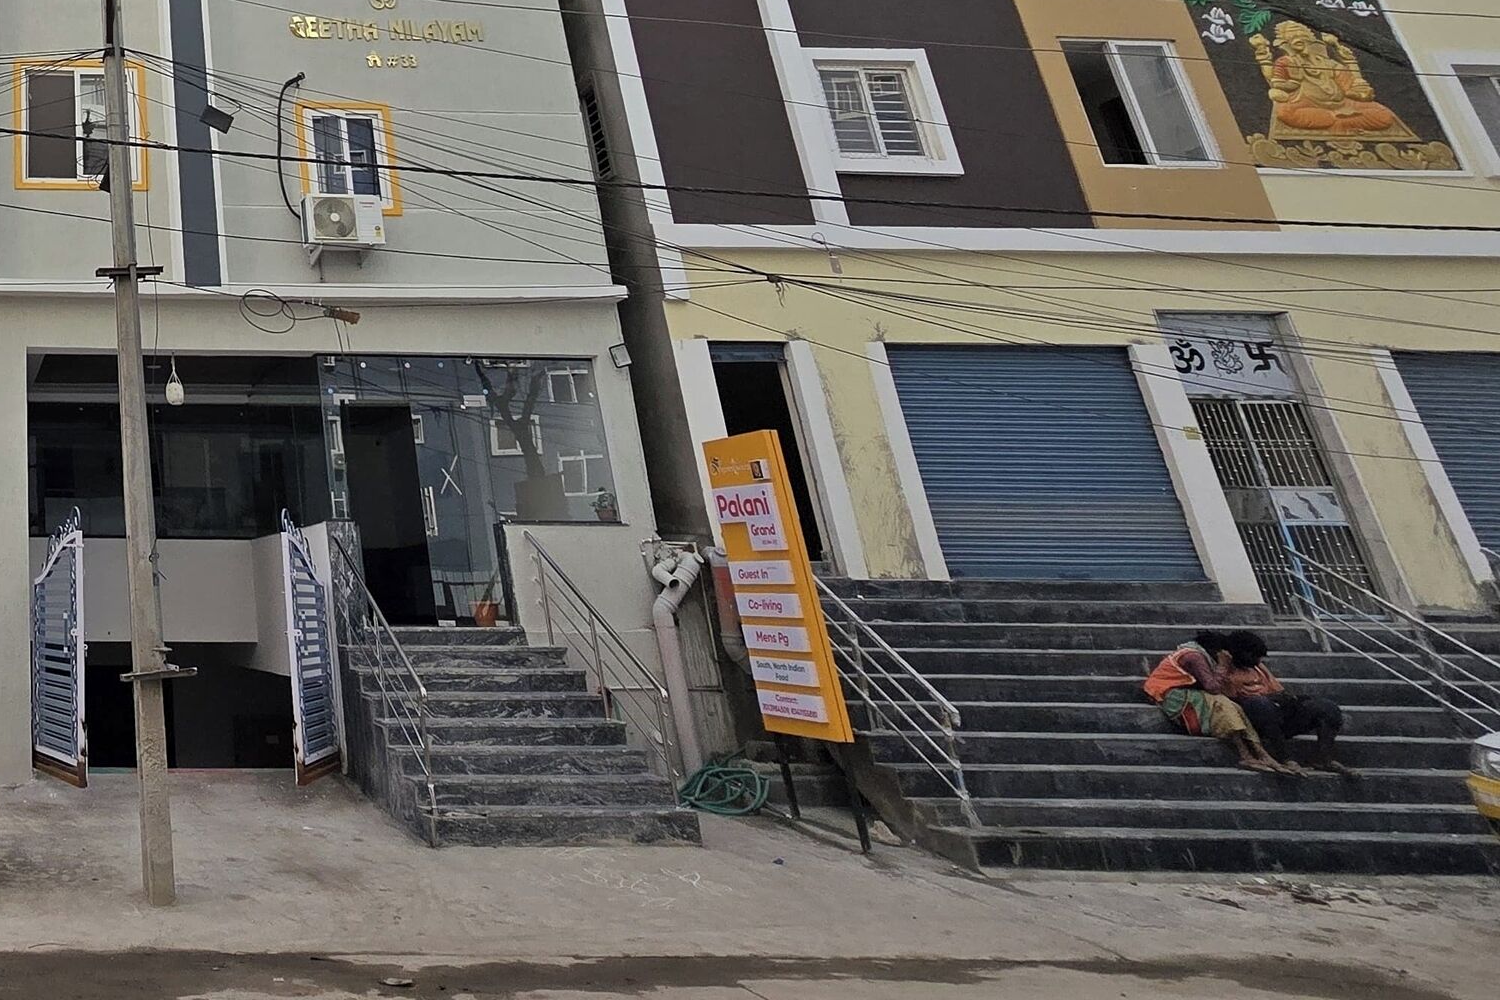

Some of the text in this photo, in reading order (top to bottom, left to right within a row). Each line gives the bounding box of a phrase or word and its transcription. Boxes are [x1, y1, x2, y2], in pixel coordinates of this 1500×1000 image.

[289, 15, 485, 44] GEETHA NILAYAM
[716, 490, 770, 518] Palani
[751, 523, 776, 536] Grand
[738, 568, 769, 580] Guest In
[748, 599, 783, 614] Co-living
[756, 631, 790, 647] Mens Pg
[773, 663, 788, 671] North
[788, 664, 806, 673] Indian
[775, 672, 789, 682] Food
